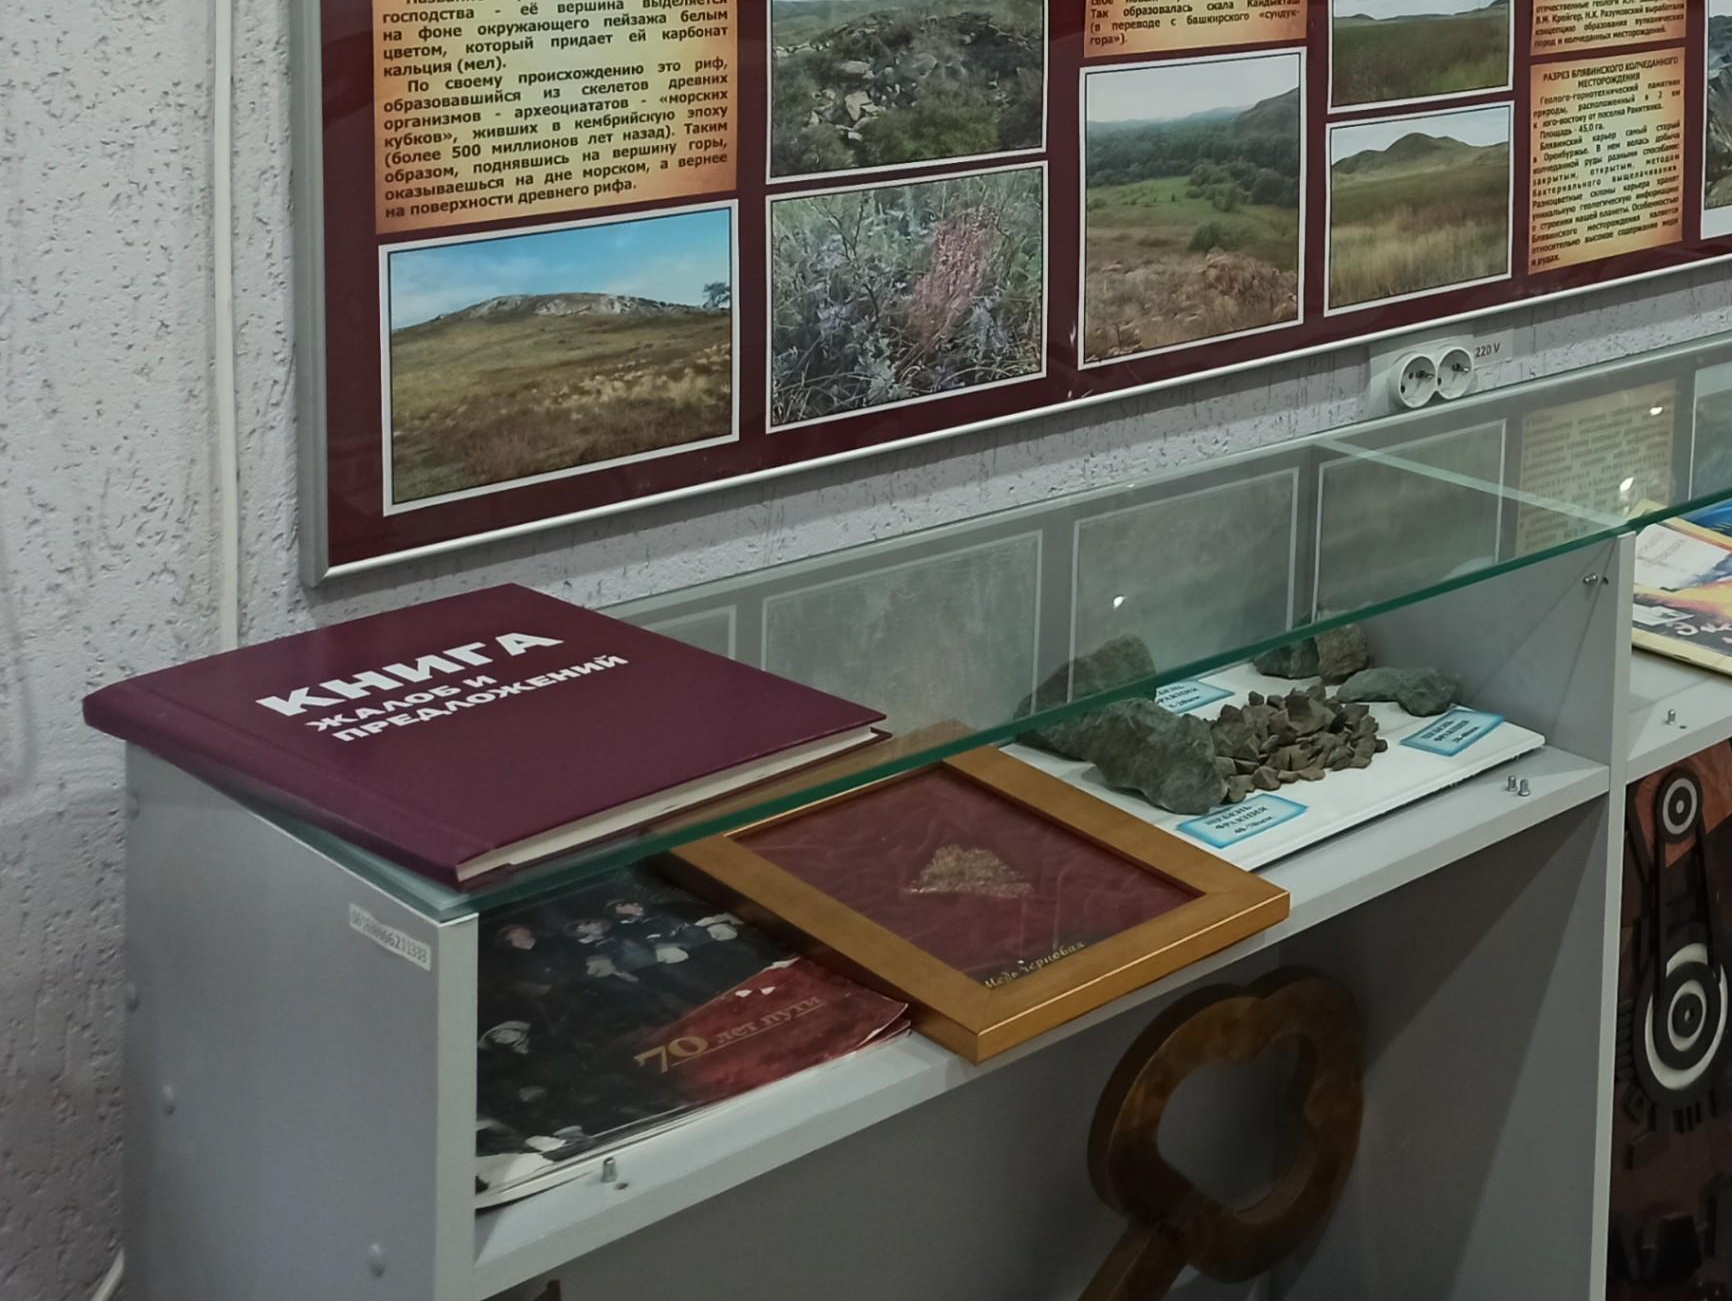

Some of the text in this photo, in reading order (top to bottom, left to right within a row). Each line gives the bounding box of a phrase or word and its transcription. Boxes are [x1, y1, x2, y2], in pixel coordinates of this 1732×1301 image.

[1475, 342, 1501, 358] 220 V
[255, 631, 565, 717] КНИГА
[304, 674, 499, 732] ЖАЛОБ И
[332, 654, 630, 742] ПРЕДЛОЖЕНИЙ
[633, 994, 822, 1074] 70 лет пути
